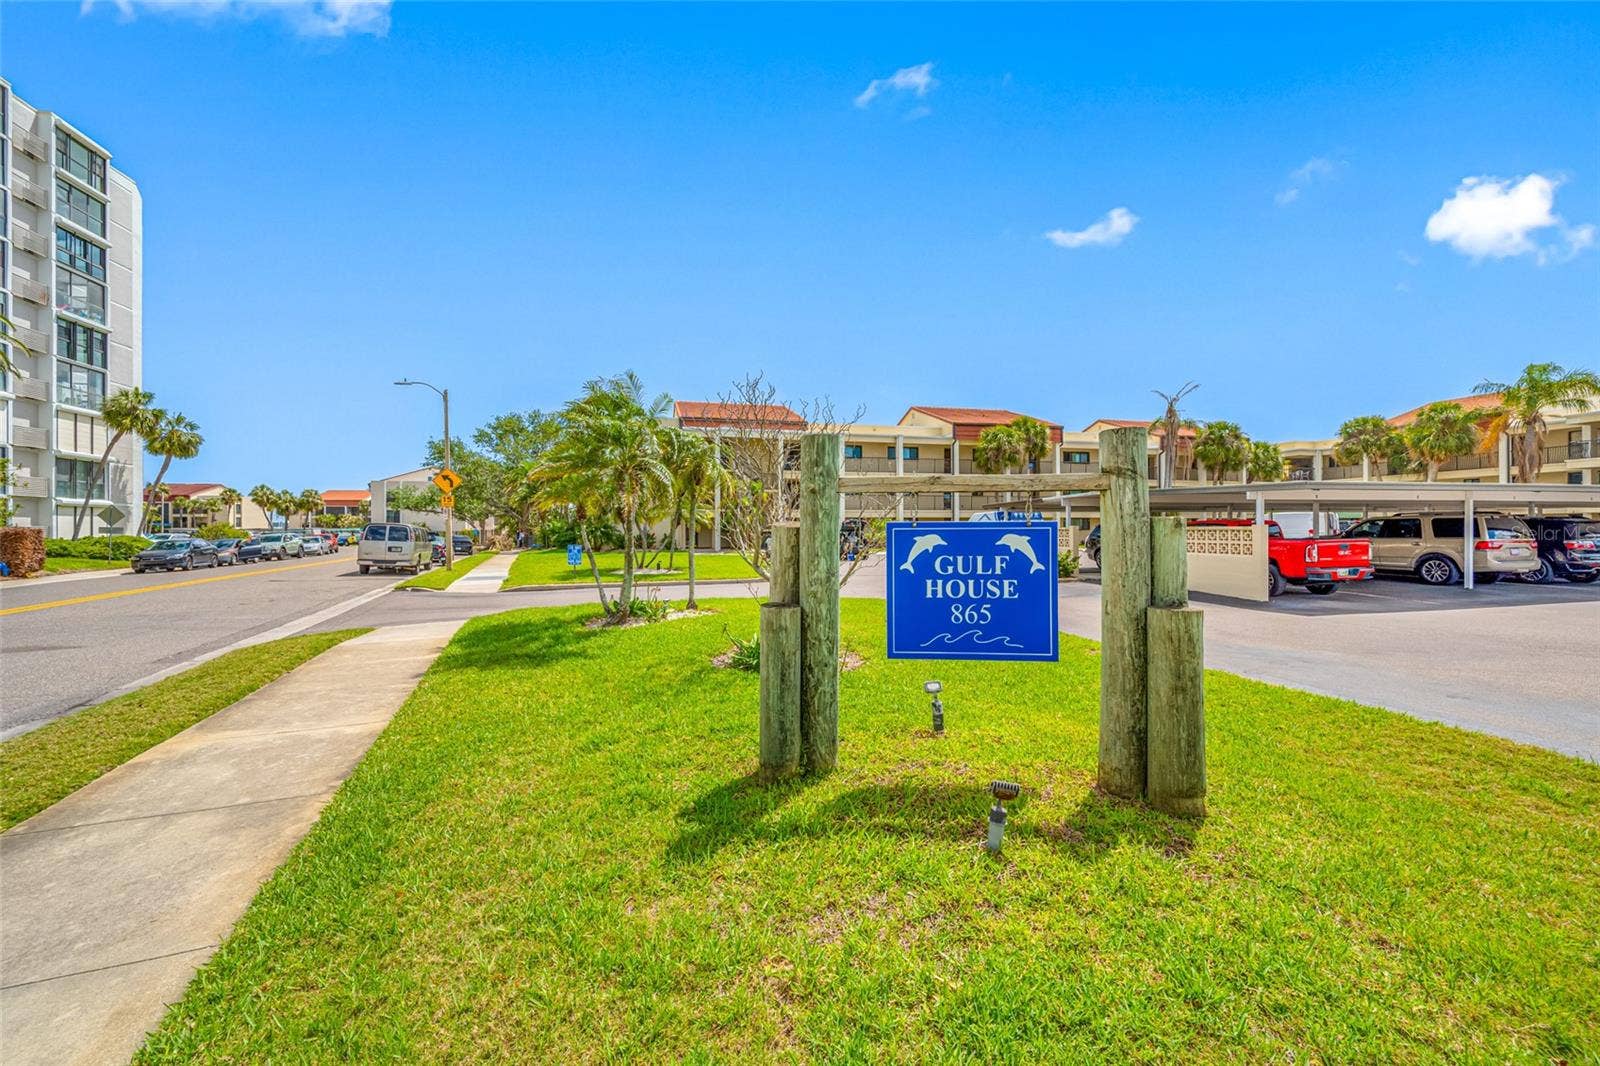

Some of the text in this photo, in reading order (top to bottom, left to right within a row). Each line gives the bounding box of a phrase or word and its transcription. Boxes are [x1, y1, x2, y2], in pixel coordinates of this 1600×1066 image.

[934, 555, 1009, 575] GULF
[925, 579, 1019, 599] HOUSE
[951, 603, 992, 624] 865
